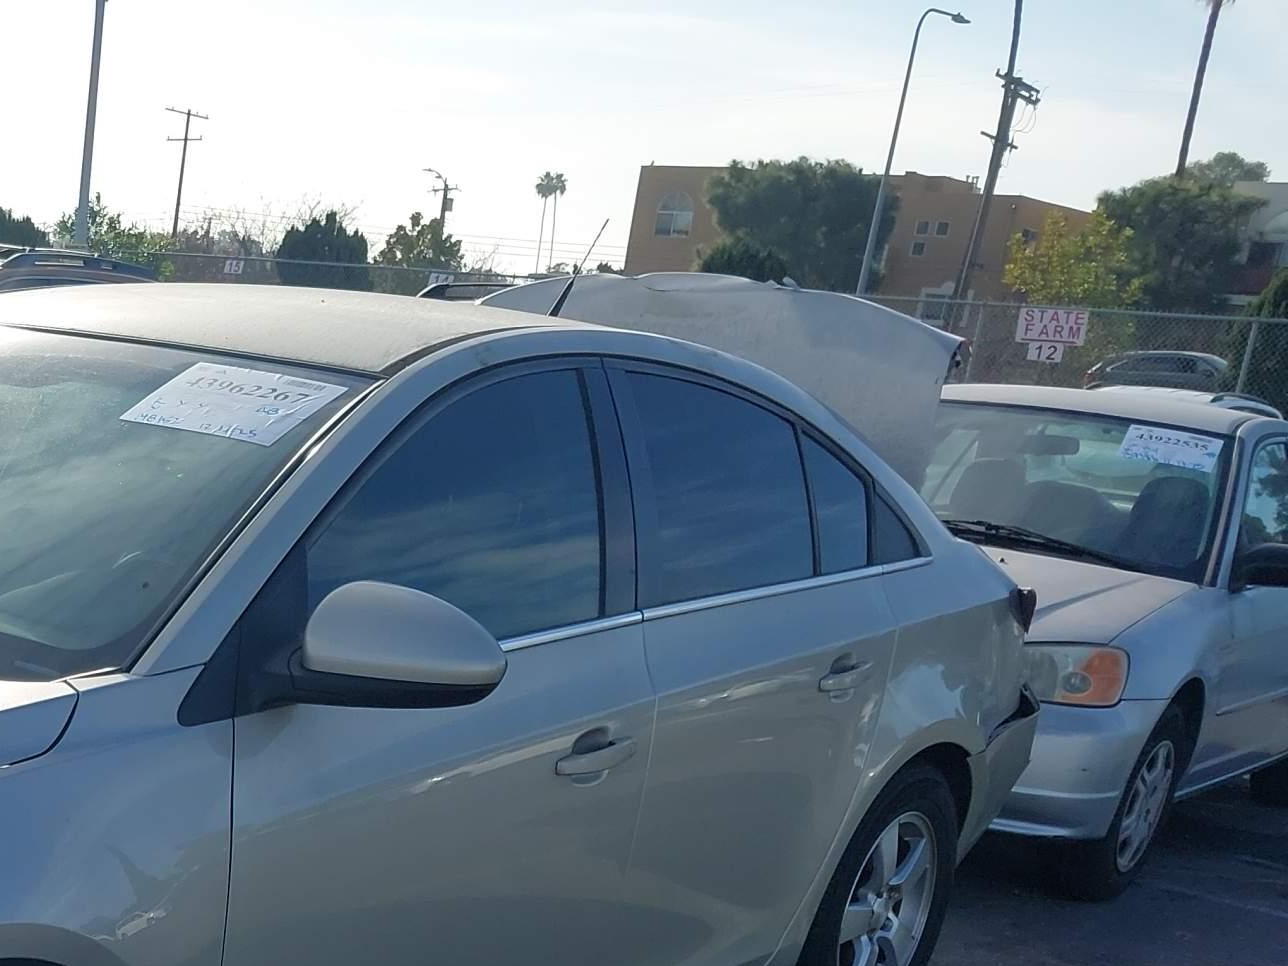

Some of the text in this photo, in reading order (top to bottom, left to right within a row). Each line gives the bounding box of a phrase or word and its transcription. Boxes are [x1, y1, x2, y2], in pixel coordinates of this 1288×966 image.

[228, 261, 241, 273] 15
[1024, 310, 1085, 326] STATE
[1024, 323, 1081, 340] FARM
[1035, 345, 1058, 361] 12
[186, 375, 311, 404] 43962267
